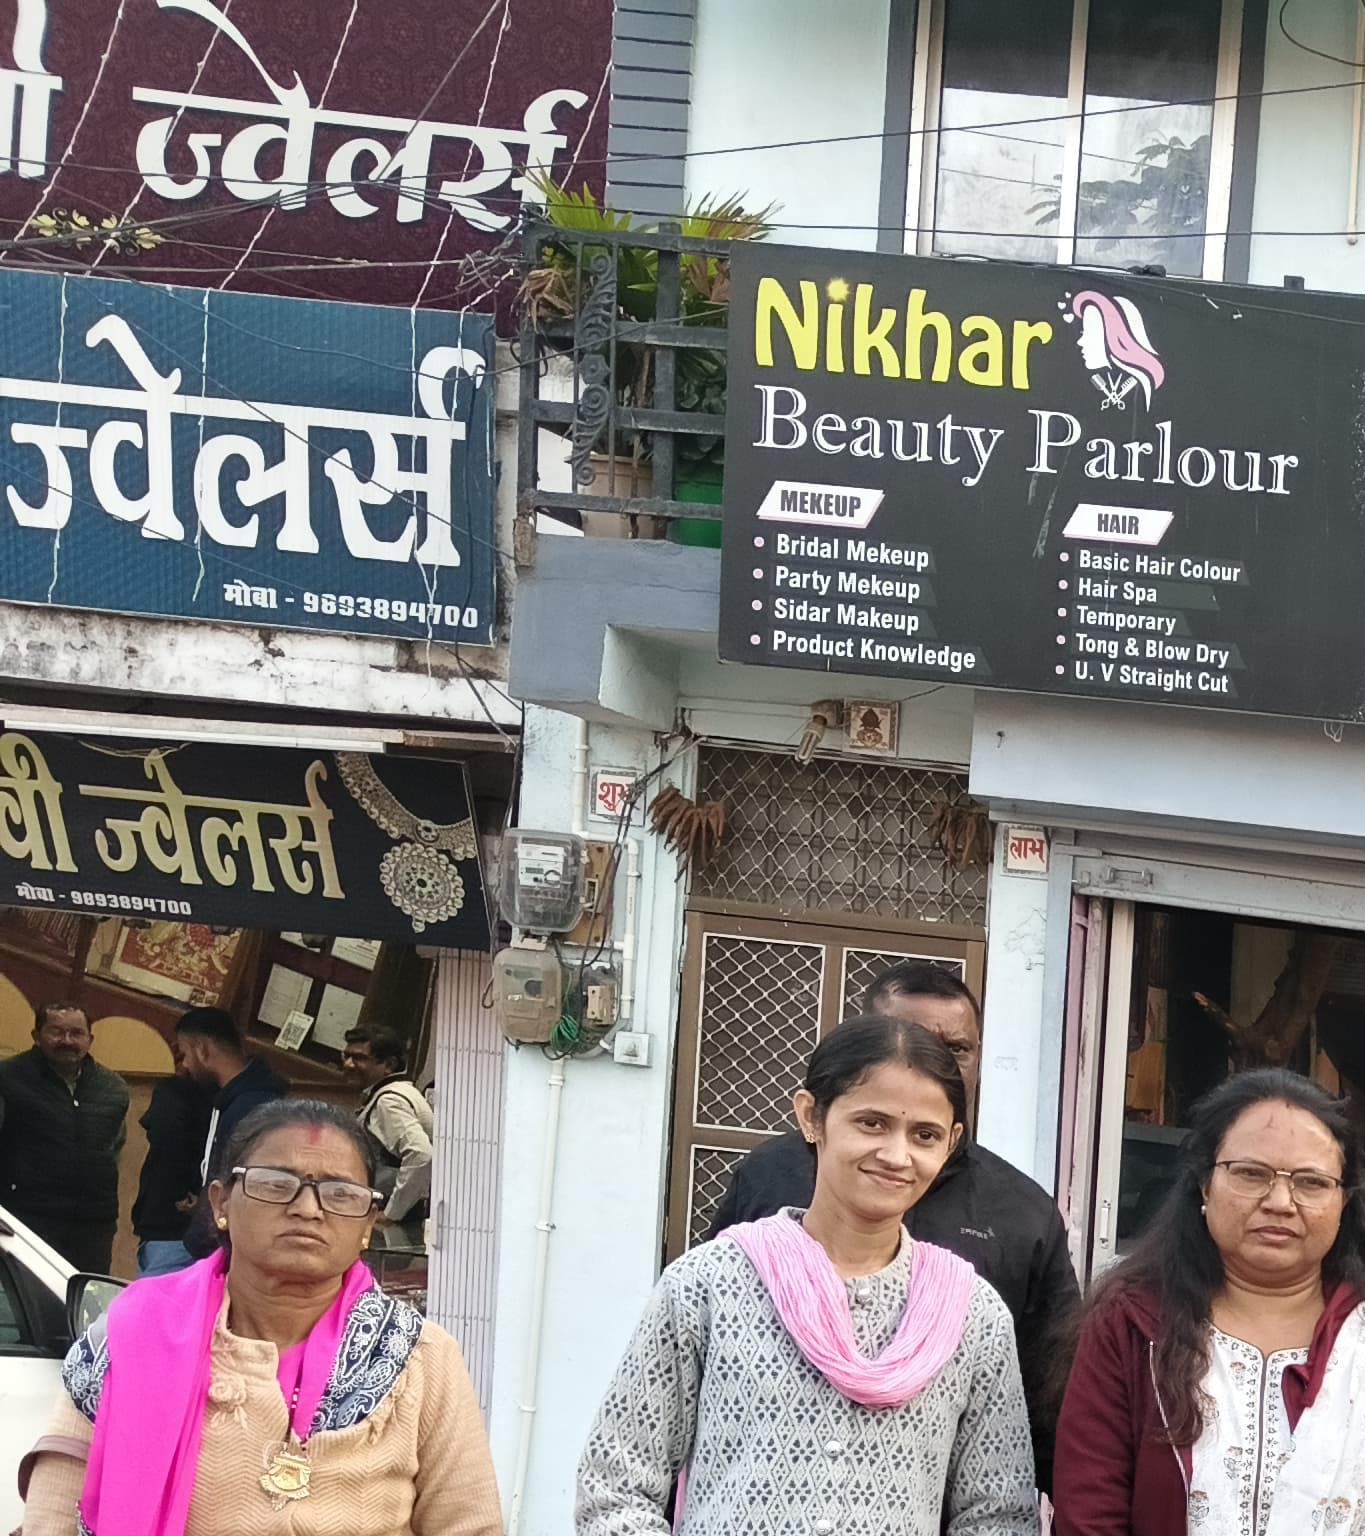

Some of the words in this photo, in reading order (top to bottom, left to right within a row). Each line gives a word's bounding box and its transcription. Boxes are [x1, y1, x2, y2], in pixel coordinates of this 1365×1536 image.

[754, 277, 1053, 390] Nikhar
[0, 314, 486, 568] ज्वेलर्स
[753, 384, 1005, 486] Beauty
[1025, 408, 1299, 496] Parlour
[780, 489, 862, 518] MEKEUP
[1097, 513, 1140, 536] HAIR
[776, 533, 839, 559] Bridal
[846, 539, 929, 572] Mekeup
[1079, 549, 1130, 572] Basic
[1135, 554, 1175, 576] Hair
[1180, 558, 1241, 582] Colour
[775, 565, 831, 596] Party
[838, 571, 920, 604] Mekeup
[1078, 577, 1118, 599] Hair
[1122, 581, 1157, 605] Spa
[224, 579, 278, 609] मोबा
[303, 591, 479, 628] 9893894700
[774, 597, 831, 623] Sidar
[837, 603, 919, 636] Makeup
[1076, 605, 1177, 636] Temporary
[773, 630, 854, 658] Product
[860, 637, 976, 673] Knowledge
[1075, 633, 1119, 659] Tong
[1124, 637, 1140, 657] &
[1145, 639, 1191, 661] Blow
[1195, 644, 1229, 669] Dry
[1075, 660, 1094, 680] U.
[1101, 663, 1114, 682] V
[1119, 664, 1192, 692] Straight
[1198, 672, 1229, 693] Cut
[80, 747, 346, 899] ज्वेलर्स
[1010, 836, 1045, 863] लाभ
[71, 890, 193, 916] 9893894700
